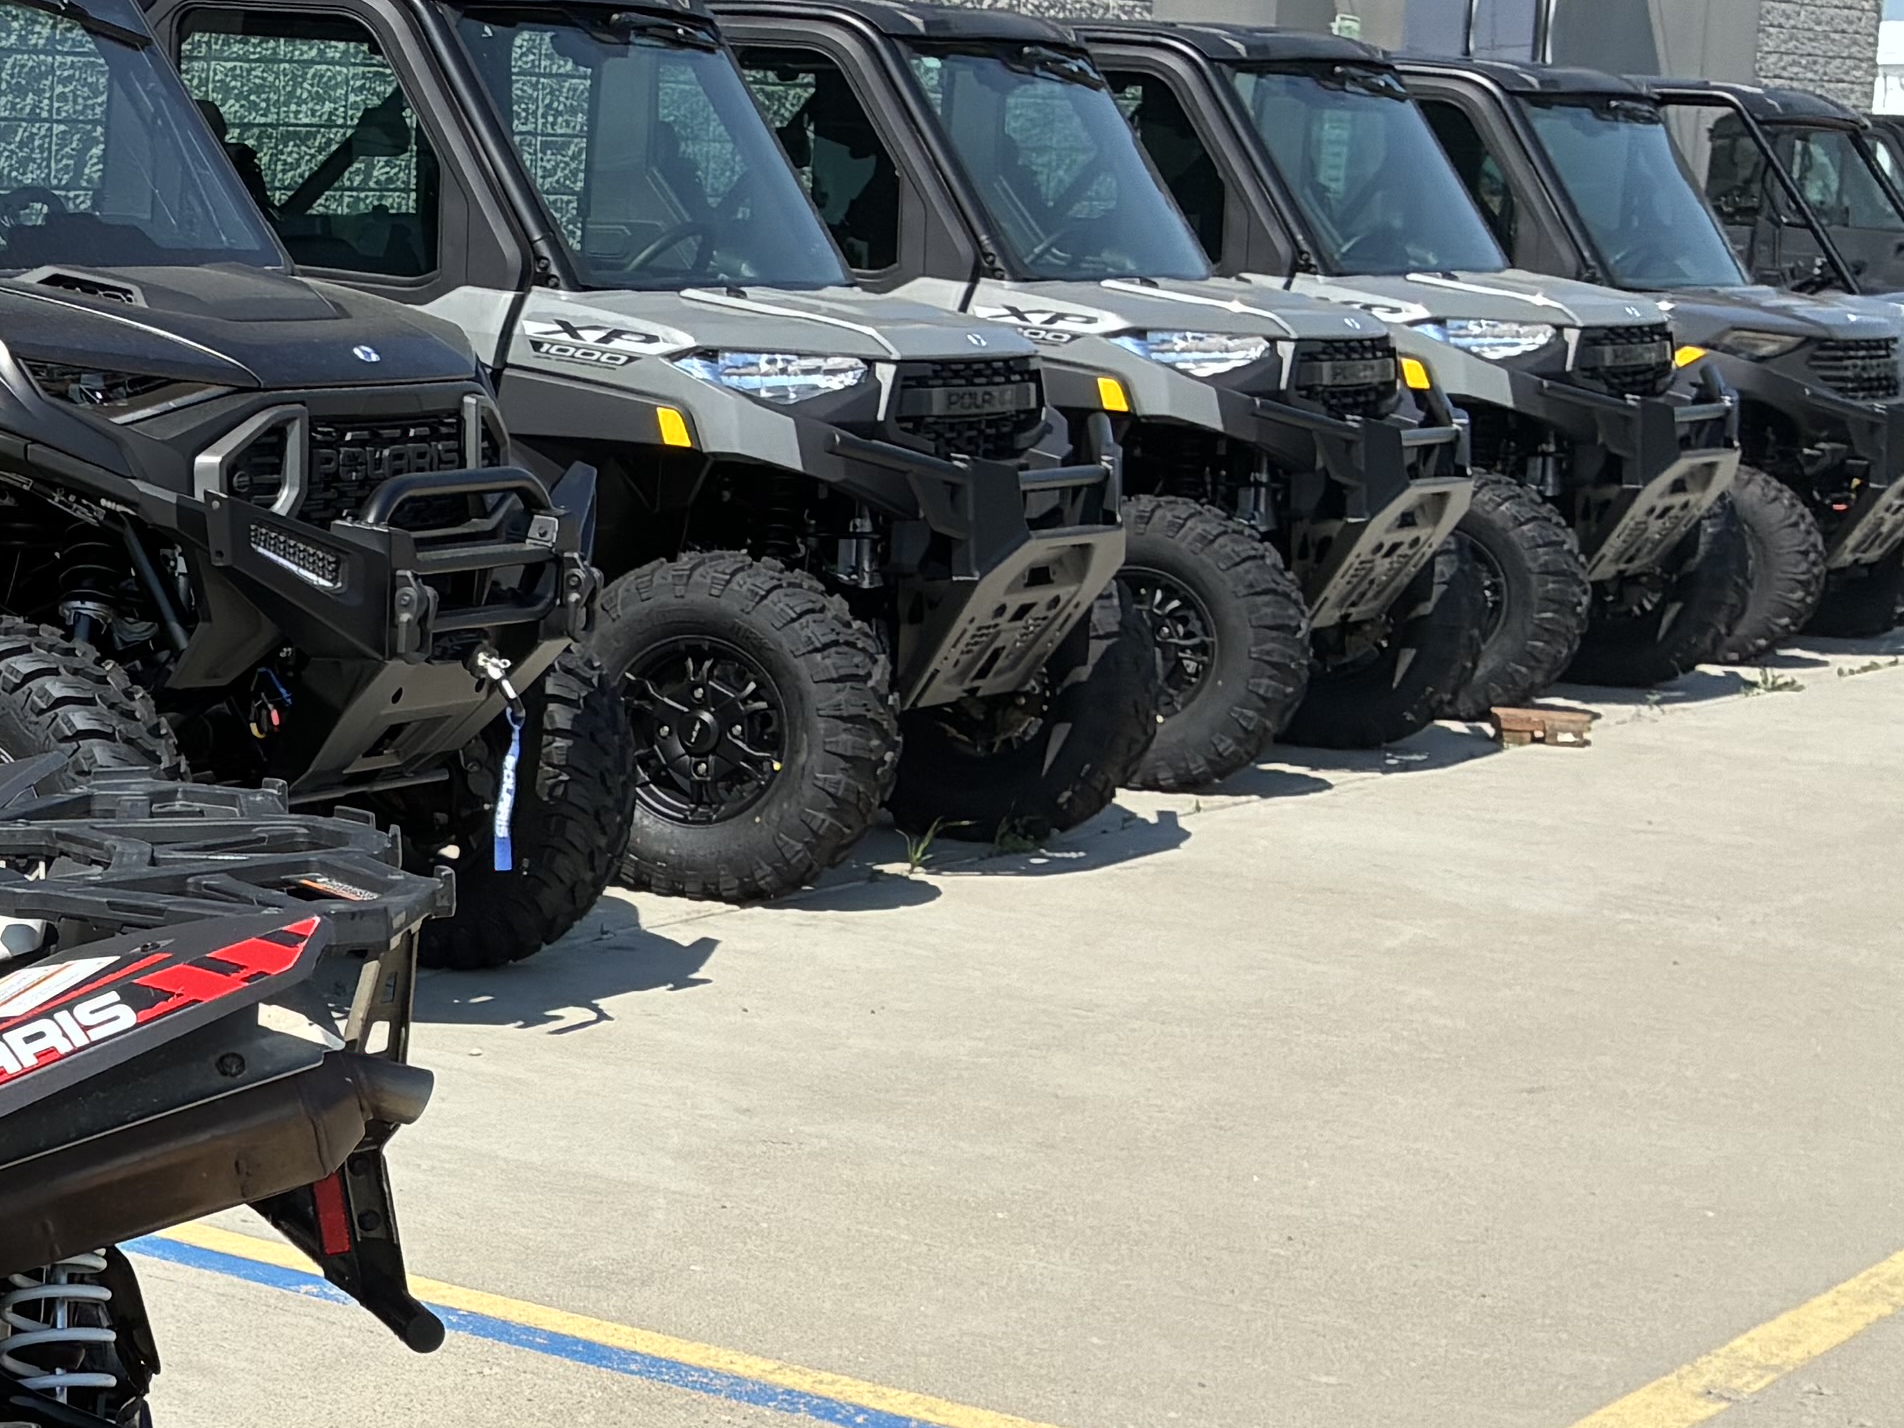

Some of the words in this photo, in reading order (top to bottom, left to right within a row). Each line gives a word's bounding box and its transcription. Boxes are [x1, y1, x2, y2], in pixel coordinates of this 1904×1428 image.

[987, 304, 1099, 326] XP
[533, 318, 661, 345] XP
[538, 342, 629, 366] 1000
[310, 439, 460, 485] POLARIS
